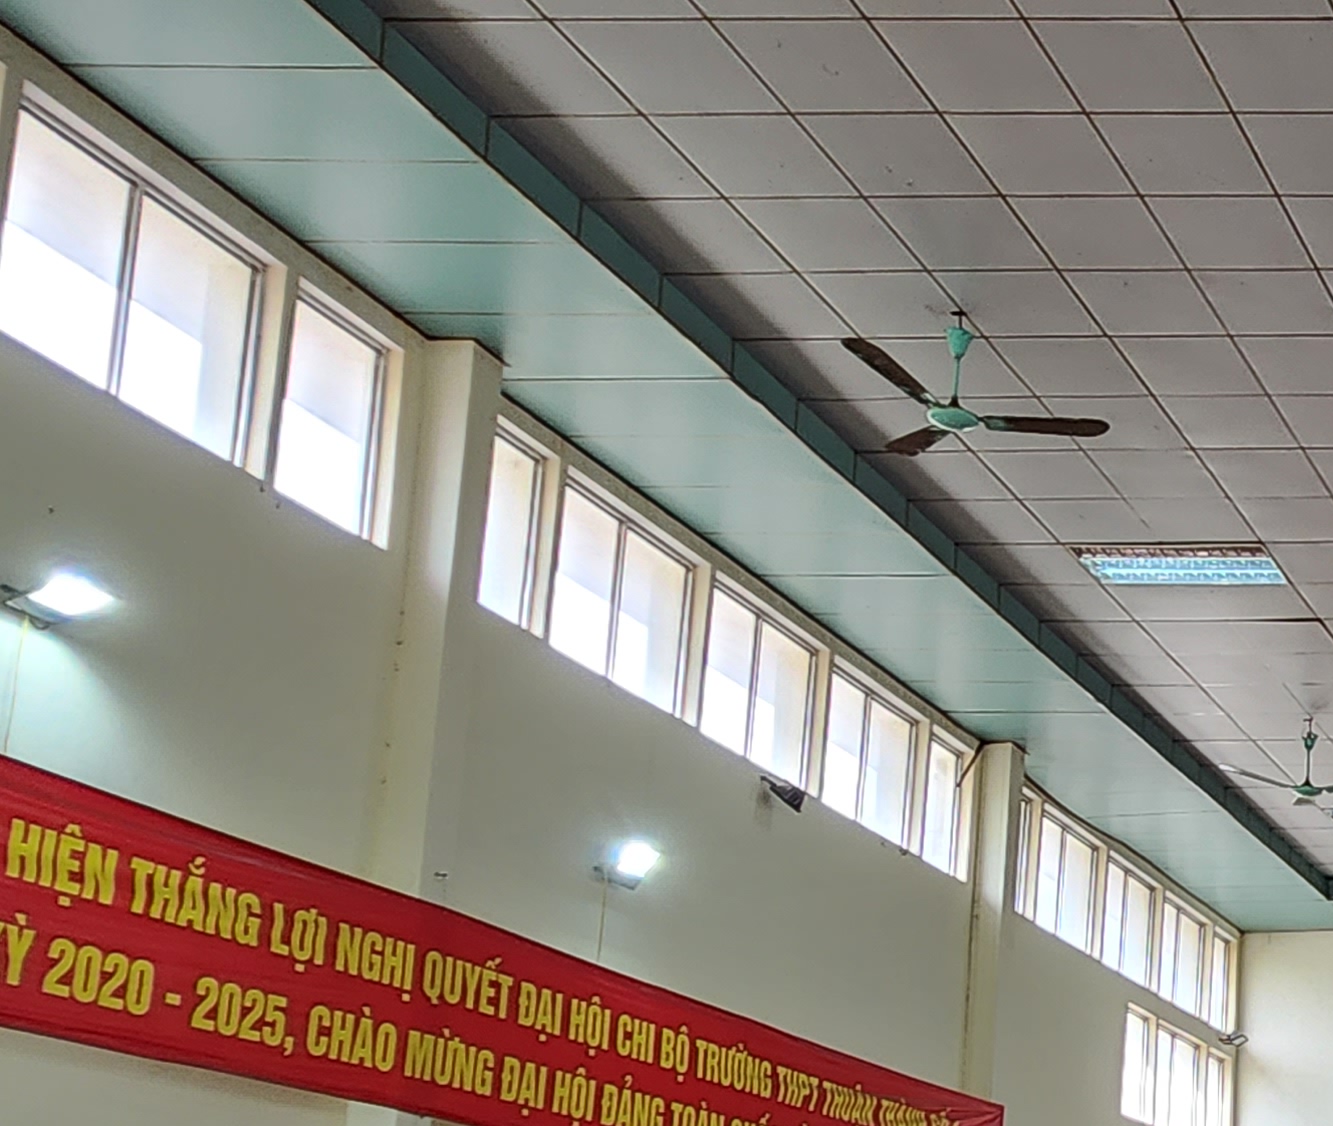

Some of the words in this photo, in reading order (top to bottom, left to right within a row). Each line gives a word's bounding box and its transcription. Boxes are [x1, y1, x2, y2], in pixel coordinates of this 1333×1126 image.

[6, 819, 119, 907] HIỆN
[130, 857, 262, 947] THẮNG
[270, 903, 328, 973] LỢI
[336, 922, 416, 1002] NGHỊ
[422, 951, 514, 1019] QUYẾT
[518, 981, 563, 1042] ĐẠI
[568, 995, 611, 1057] HỘI
[617, 1013, 656, 1064] CHI
[660, 1024, 690, 1082] BỘ
[696, 1039, 772, 1099] TRƯỜNG
[776, 1065, 819, 1112] THPT
[42, 938, 155, 1016] 2020
[164, 989, 182, 1007] -
[191, 977, 295, 1058] 2025,
[307, 1005, 397, 1073] CHÀO
[404, 1027, 495, 1098] MỪNG
[500, 1056, 548, 1116] ĐẠI
